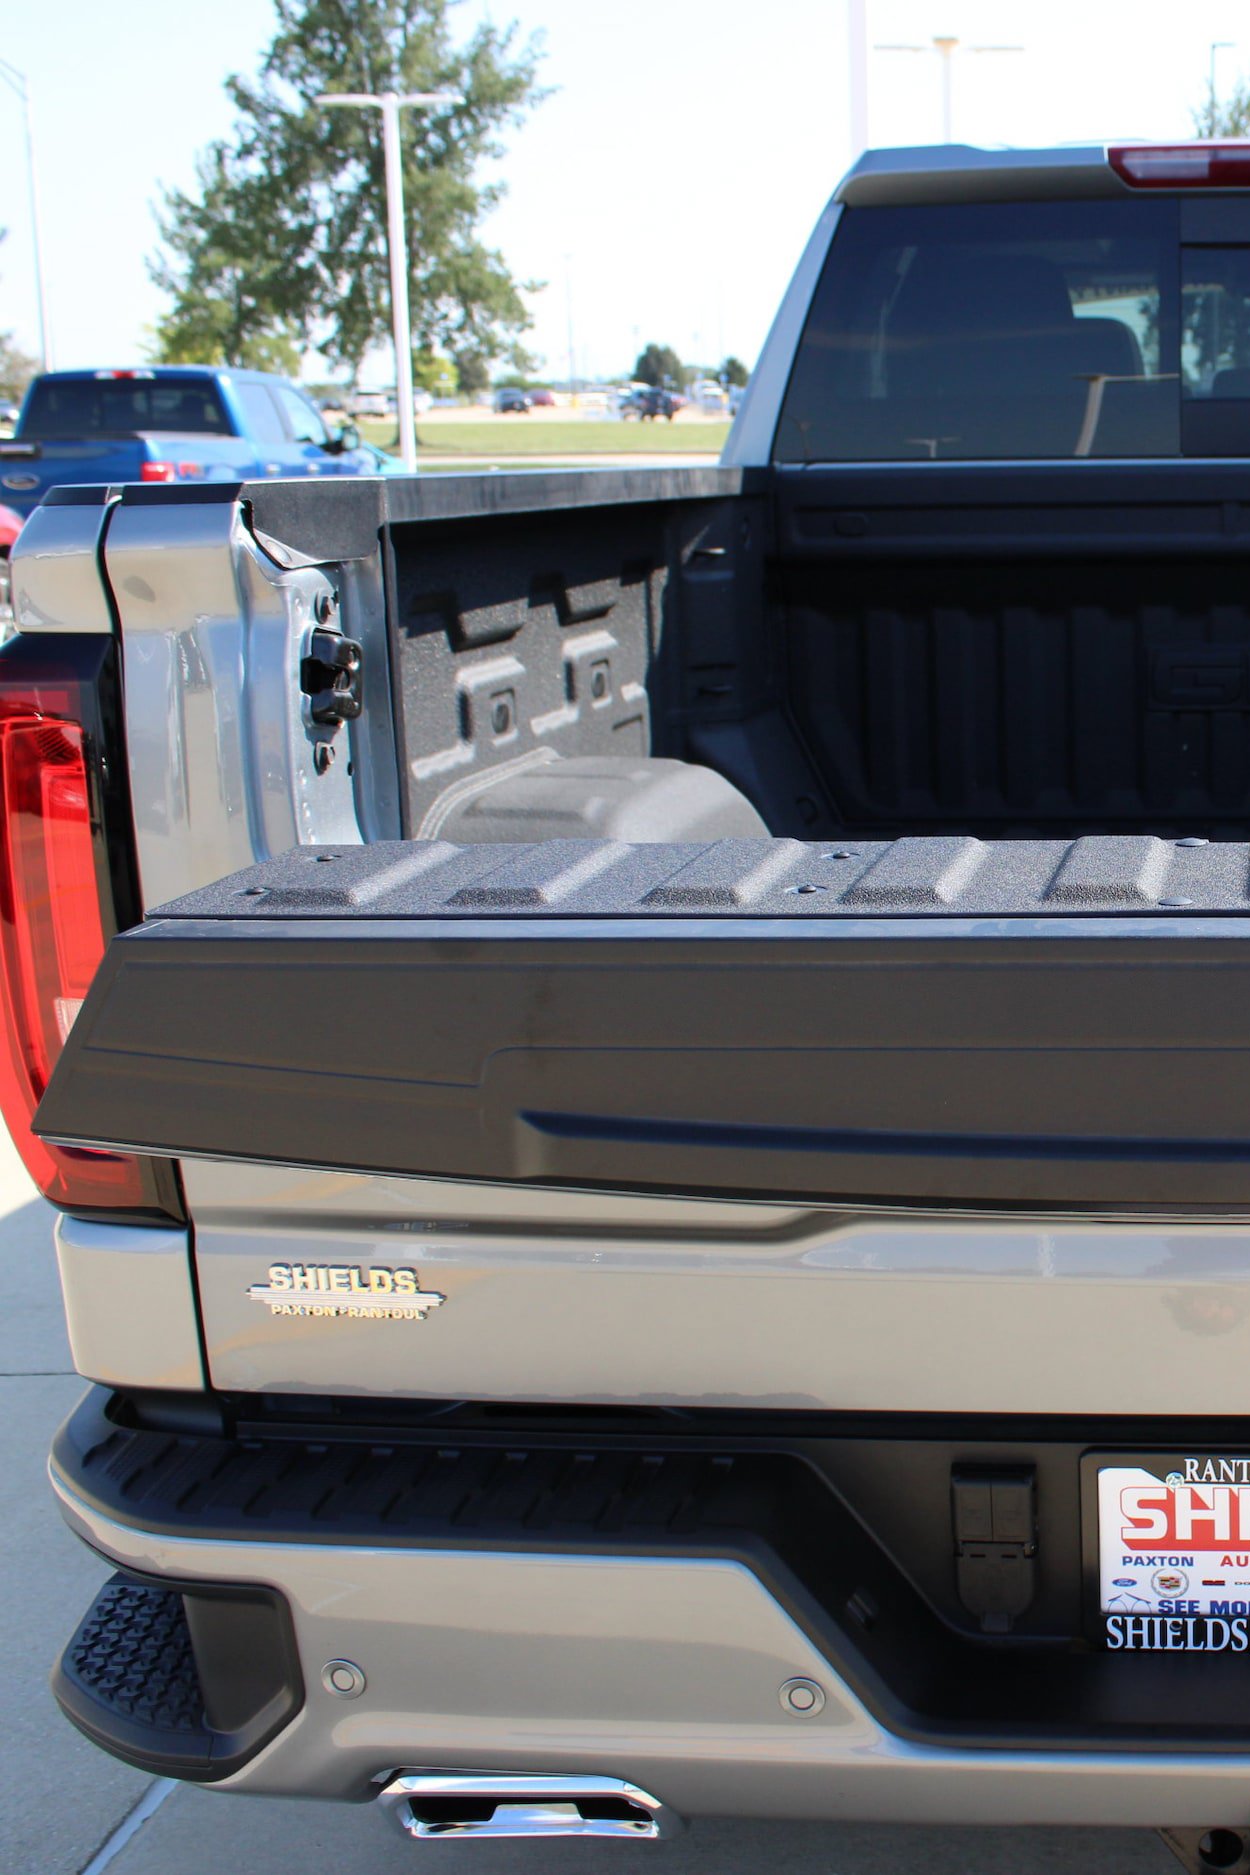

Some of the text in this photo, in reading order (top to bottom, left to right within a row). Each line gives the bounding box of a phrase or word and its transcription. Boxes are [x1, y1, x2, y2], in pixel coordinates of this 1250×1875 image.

[268, 1262, 418, 1294] SHIELDS
[270, 1304, 427, 1320] PAXTON RANTOUL
[1122, 1556, 1194, 1567] PAXTON
[1158, 1600, 1200, 1615] SEE
[1106, 1616, 1249, 1651] SHIELDS
